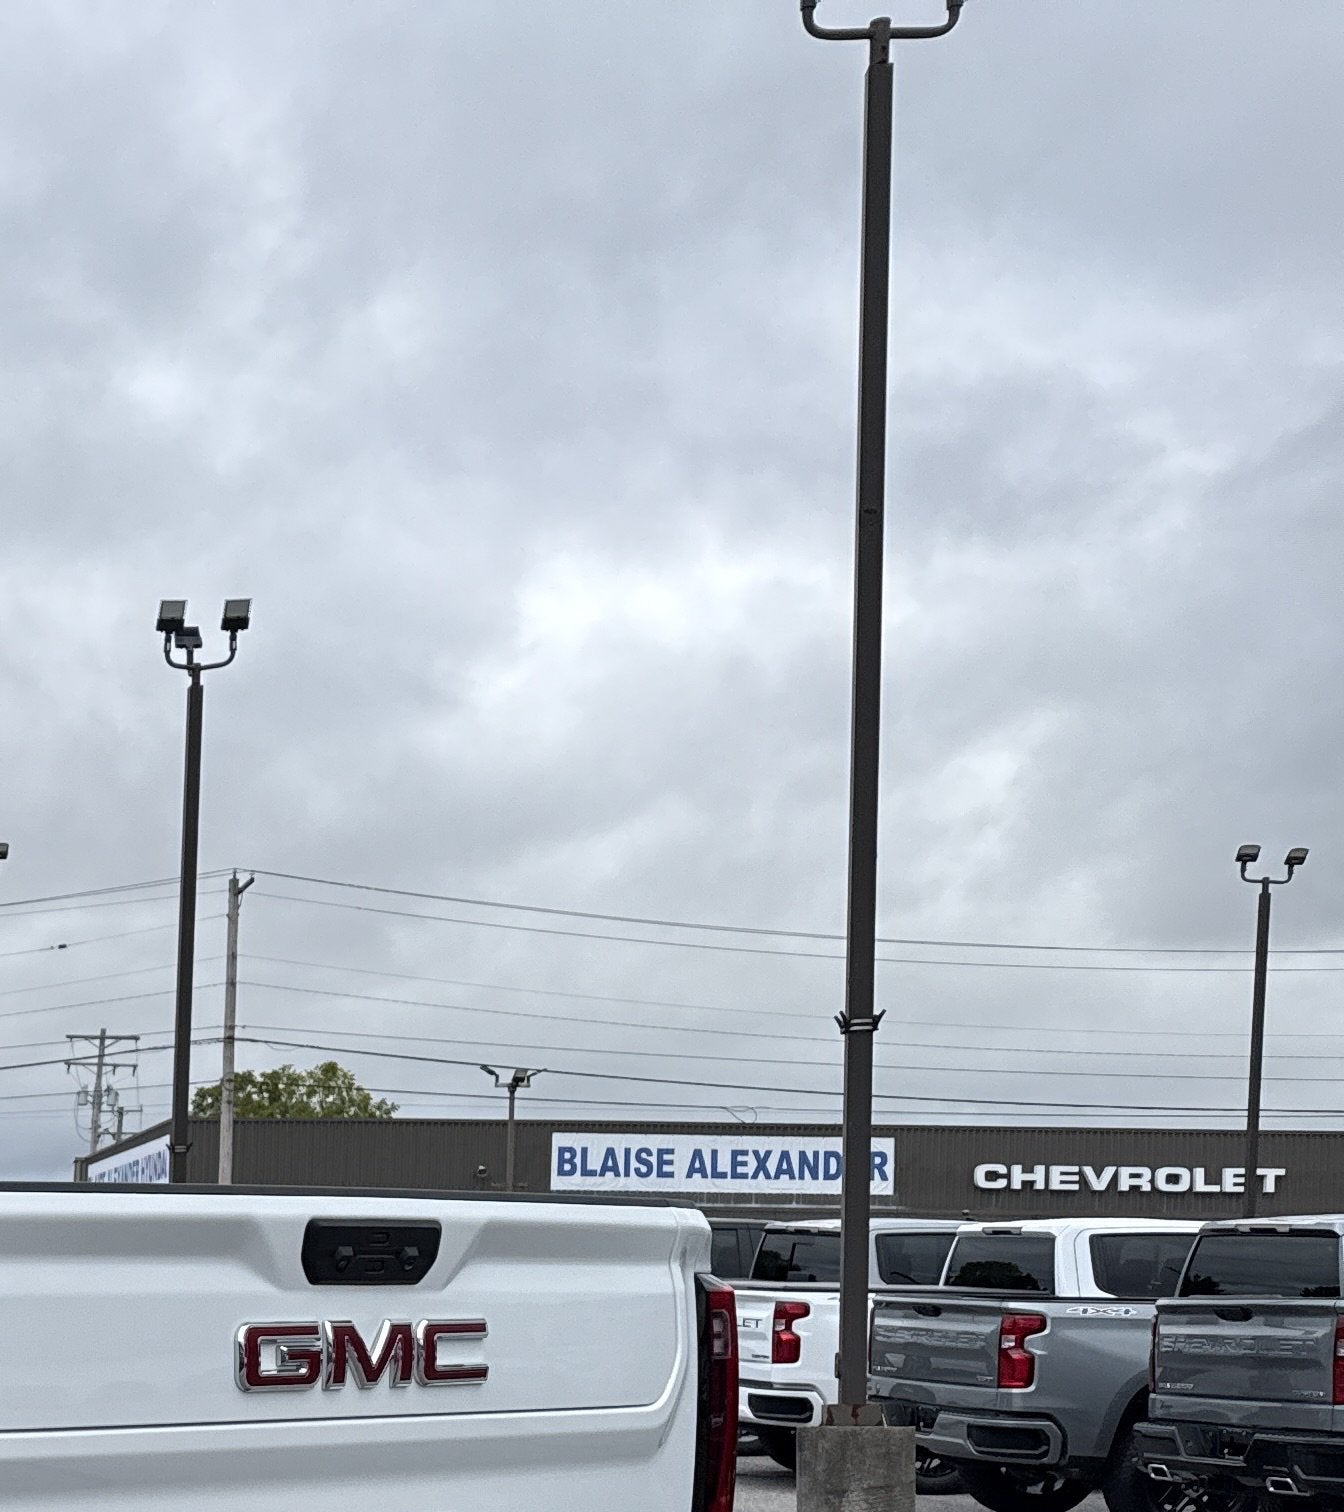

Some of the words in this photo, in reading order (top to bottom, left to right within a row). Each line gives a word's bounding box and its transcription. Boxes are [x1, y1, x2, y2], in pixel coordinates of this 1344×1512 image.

[556, 1146, 675, 1178] BLAISE
[685, 1148, 889, 1182] ALEXANDR
[973, 1163, 1286, 1193] CHEVROLET
[234, 1318, 489, 1393] GMC
